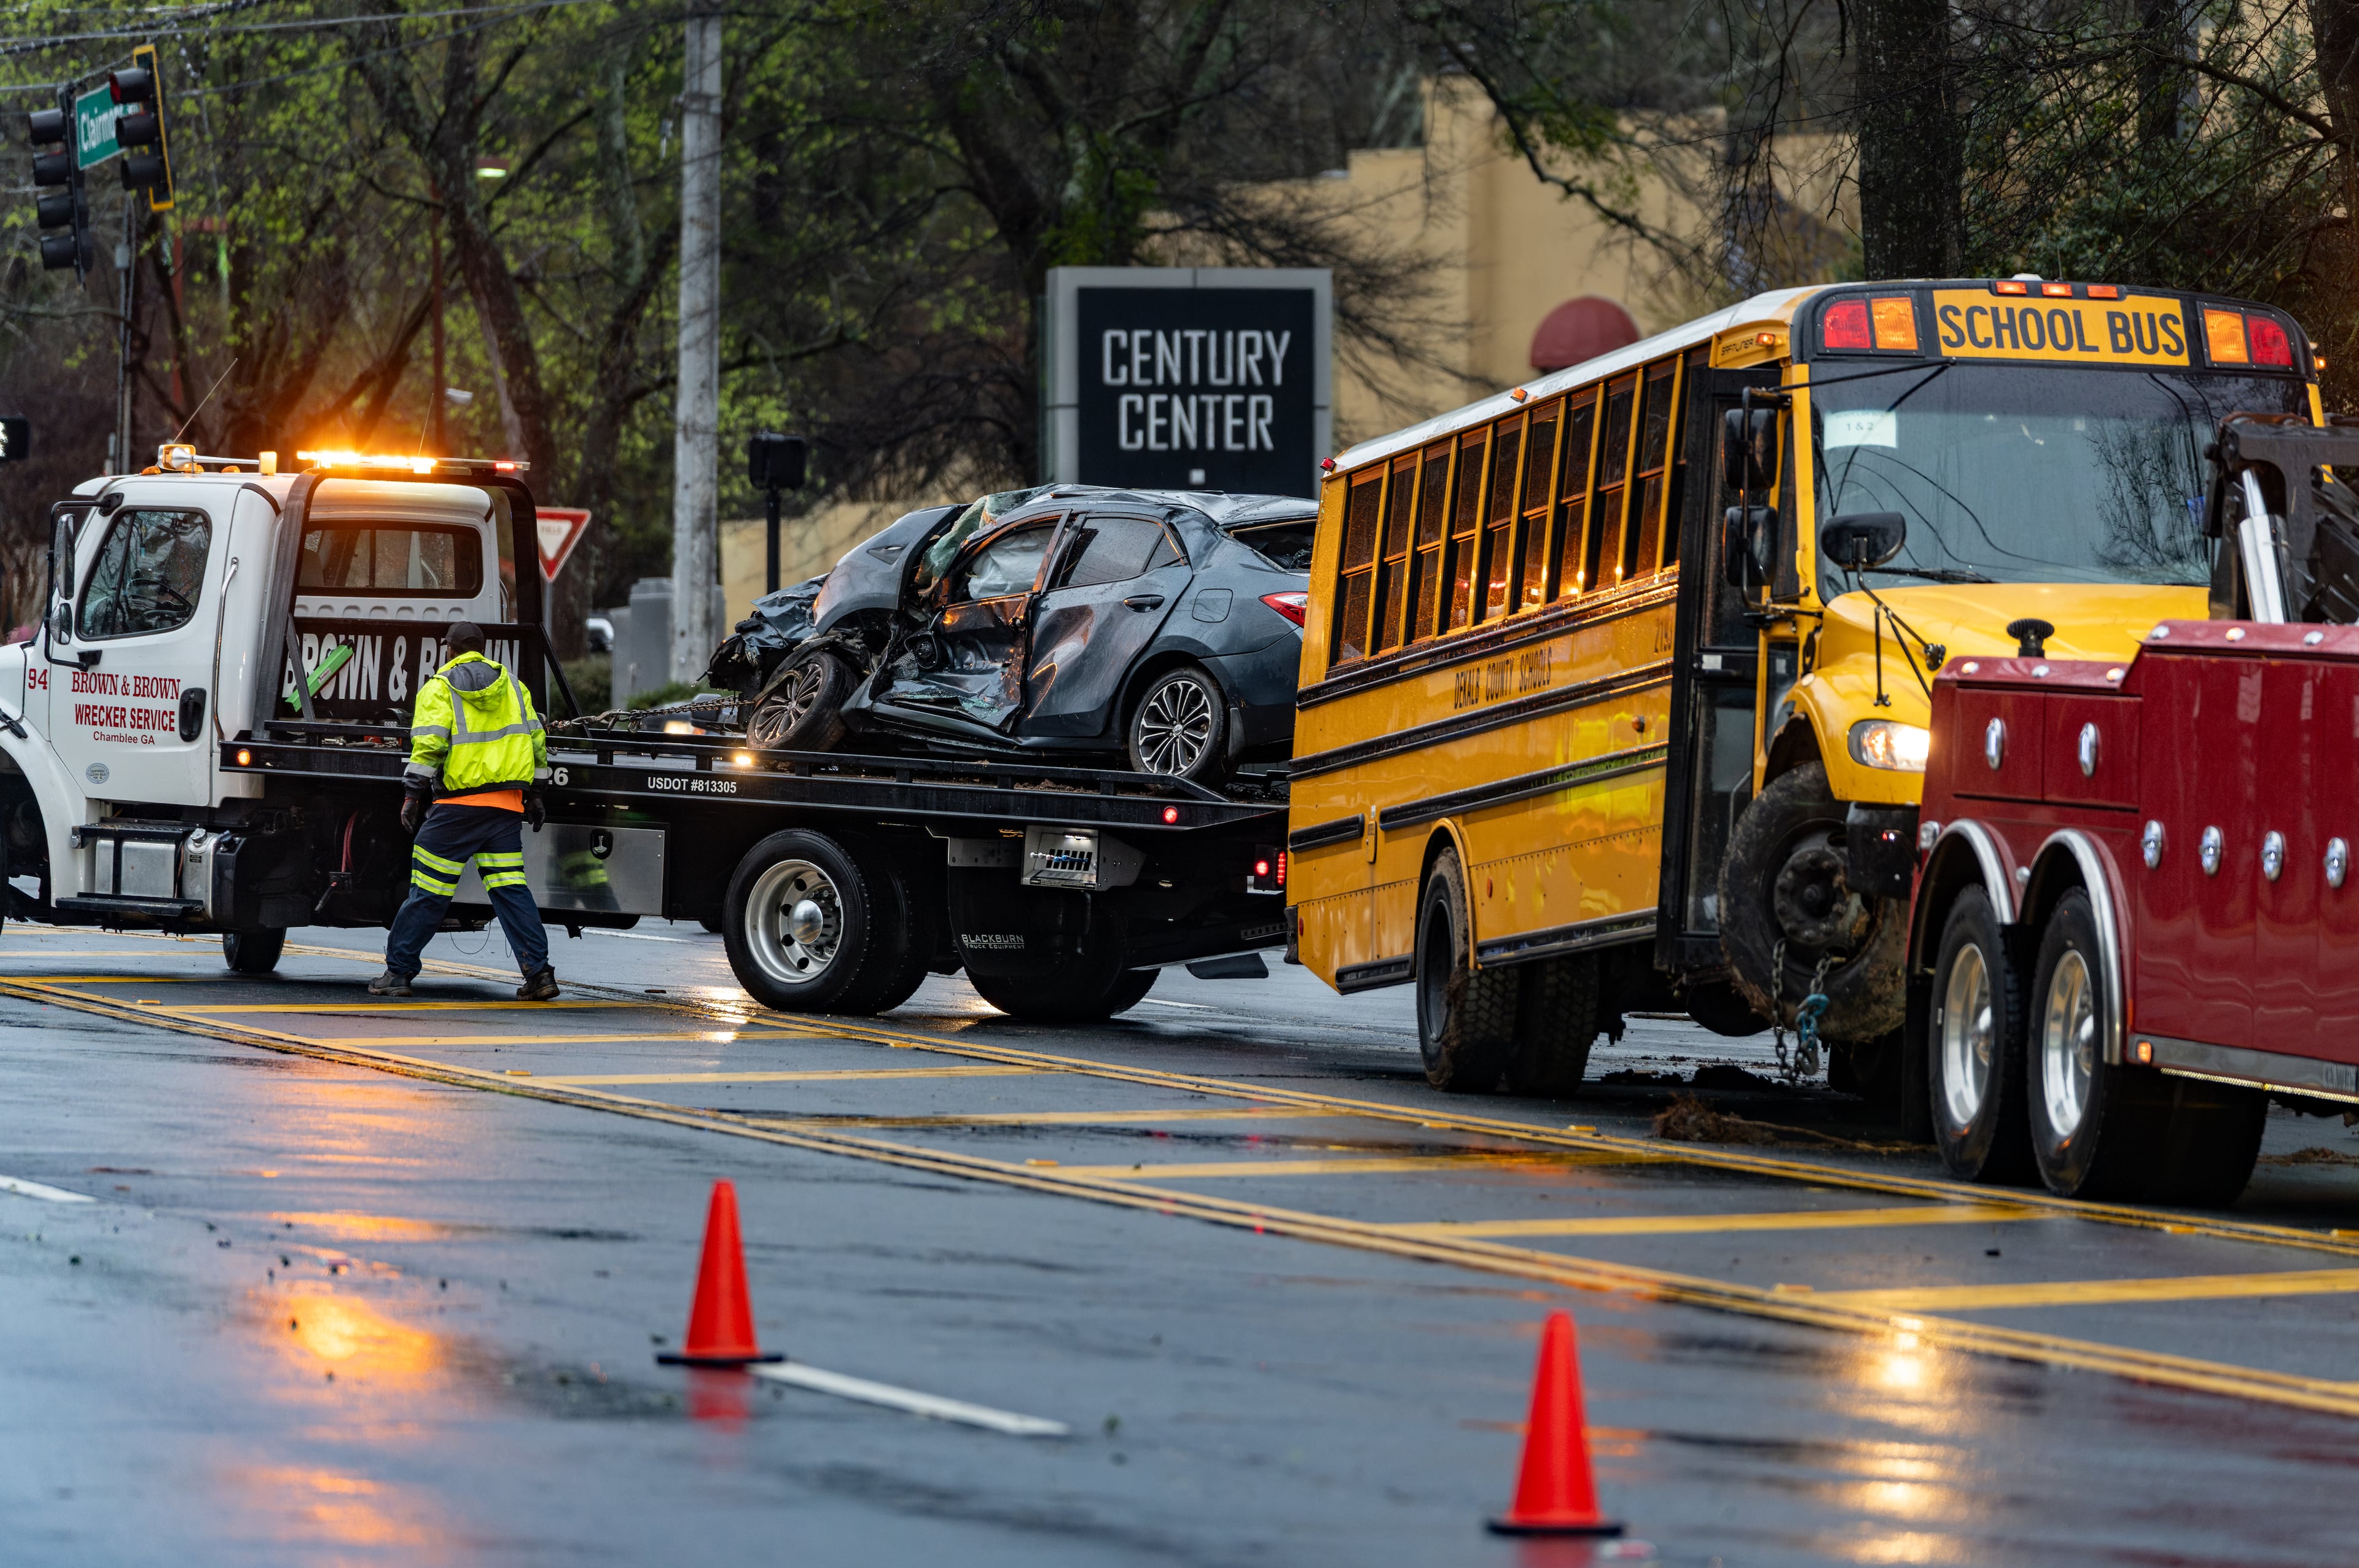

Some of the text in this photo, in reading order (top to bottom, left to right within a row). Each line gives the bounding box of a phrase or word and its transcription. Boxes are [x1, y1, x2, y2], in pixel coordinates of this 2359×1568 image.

[1939, 305, 2185, 356] SCHOOL BUS
[1102, 329, 1291, 386] CENTURY
[1119, 394, 1274, 451] CENTER
[1855, 422, 1863, 431] &
[1867, 422, 1873, 431] 2
[28, 668, 48, 690] 94
[388, 635, 407, 701] &
[1454, 646, 1552, 709] DEKALB COUNTY SCHOOLS
[71, 671, 181, 700] BROWN & BROWN
[75, 703, 175, 731] WRECKER SERVICE
[93, 731, 155, 744] Chamblee GA
[648, 777, 737, 793] USDOT #813305
[961, 934, 1024, 943] BLACKBURN
